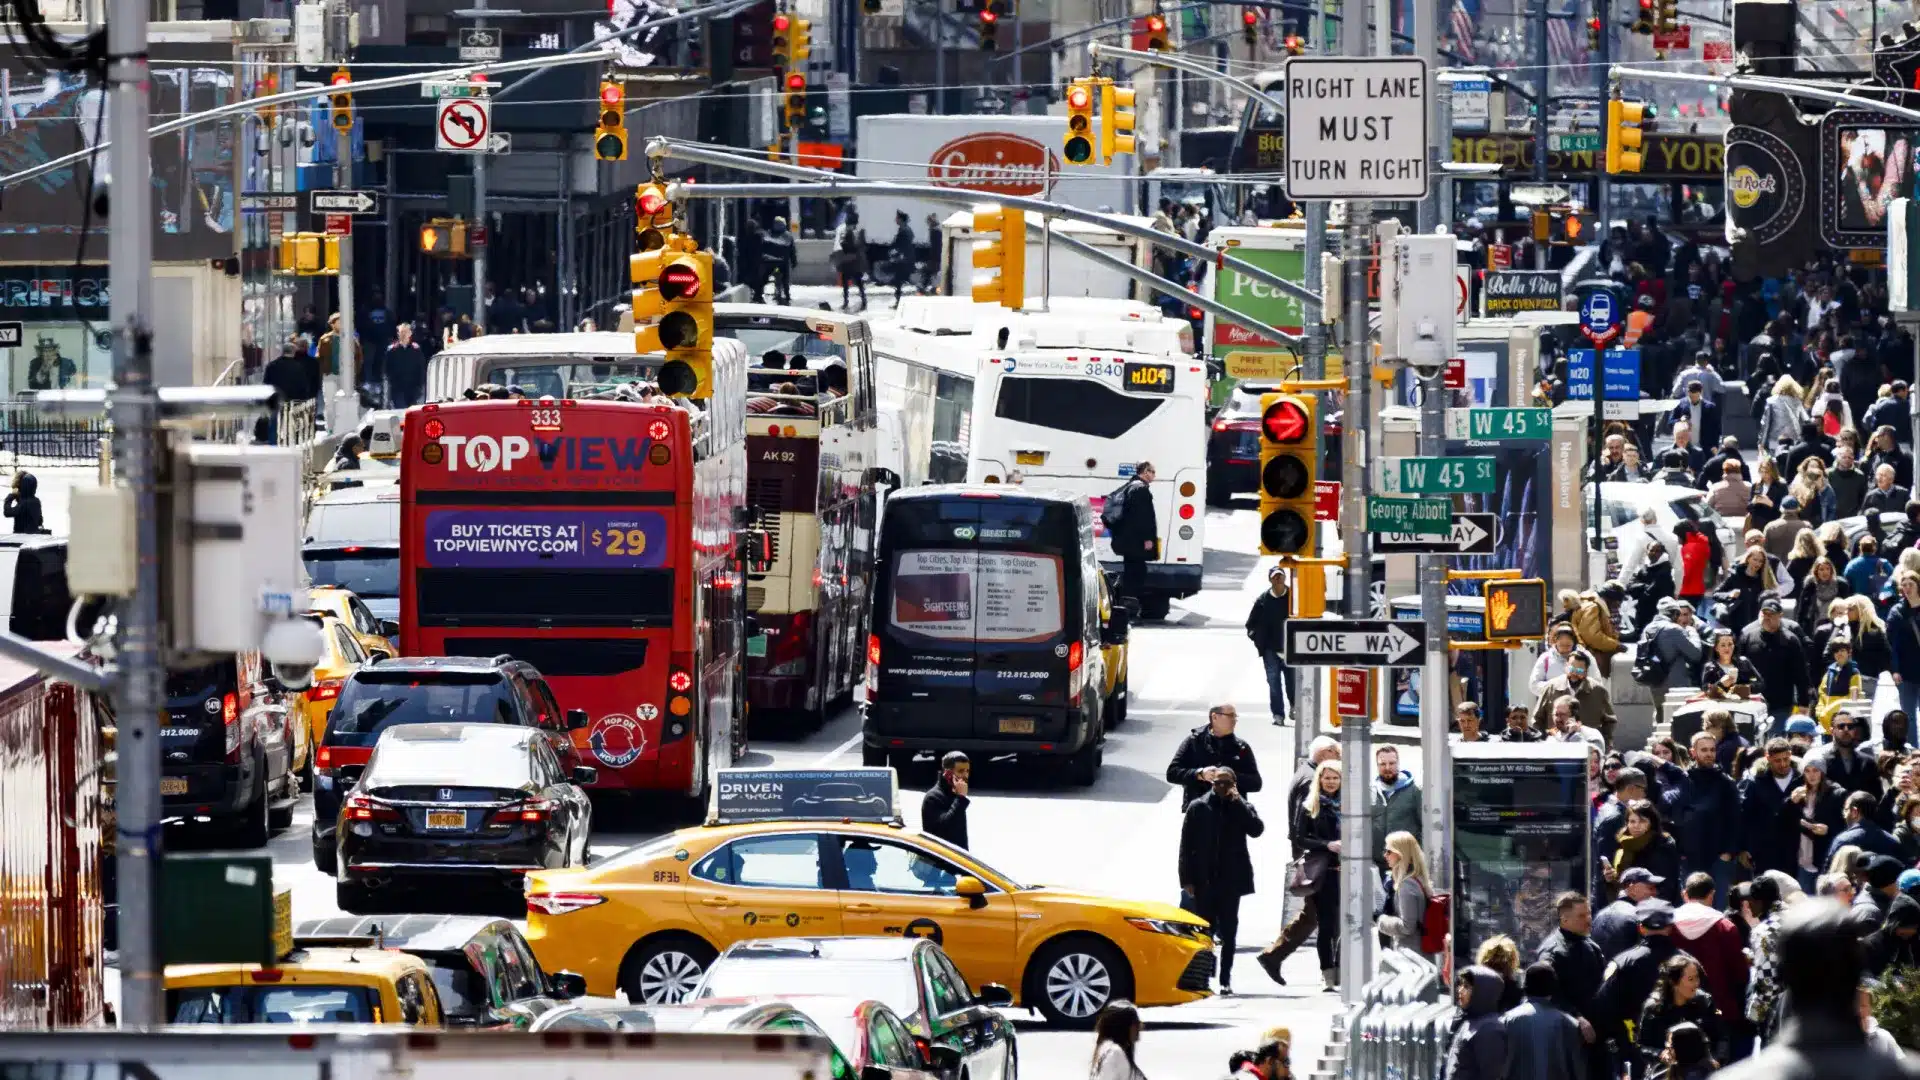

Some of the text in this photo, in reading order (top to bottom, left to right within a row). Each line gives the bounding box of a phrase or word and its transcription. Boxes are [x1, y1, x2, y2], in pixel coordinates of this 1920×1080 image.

[1293, 78, 1420, 98] RIGHT LANE
[1319, 116, 1393, 141] MUST
[1292, 159, 1422, 180] TURN RIGHT
[321, 197, 369, 208] ONE WAY
[1487, 275, 1558, 295] Bella Vita
[1488, 299, 1559, 310] BRICK OVEN PIZZA
[1241, 356, 1263, 364] FREE
[1570, 352, 1583, 363] M7
[1051, 362, 1063, 370] City
[1085, 363, 1123, 377] 3840
[1232, 367, 1269, 377] Delivery
[1570, 367, 1590, 380] M20
[1569, 383, 1594, 396] M104
[530, 409, 561, 426] 333
[1474, 411, 1549, 435] W 45 St
[438, 435, 651, 472] TOP VIEW
[763, 451, 795, 462] AK 92
[1406, 462, 1491, 488] W 45 St
[1370, 501, 1447, 524] George Abbott
[451, 525, 578, 537] BUY TICKETS AT
[954, 527, 971, 537] GO
[1403, 522, 1414, 533] Way
[433, 539, 578, 552] TOPVIEWNYC.COM
[591, 529, 646, 556] $ 29
[917, 554, 927, 563] Top
[951, 555, 961, 565] Top
[923, 602, 969, 612] SIGHTSEEING
[1306, 634, 1406, 652] ONE WAY
[888, 667, 1049, 679] www.goairlinknyc.com 212.812.9000
[604, 717, 636, 730] HOP ON
[599, 752, 632, 764] HOP OFF
[720, 783, 783, 793] DRIVEN
